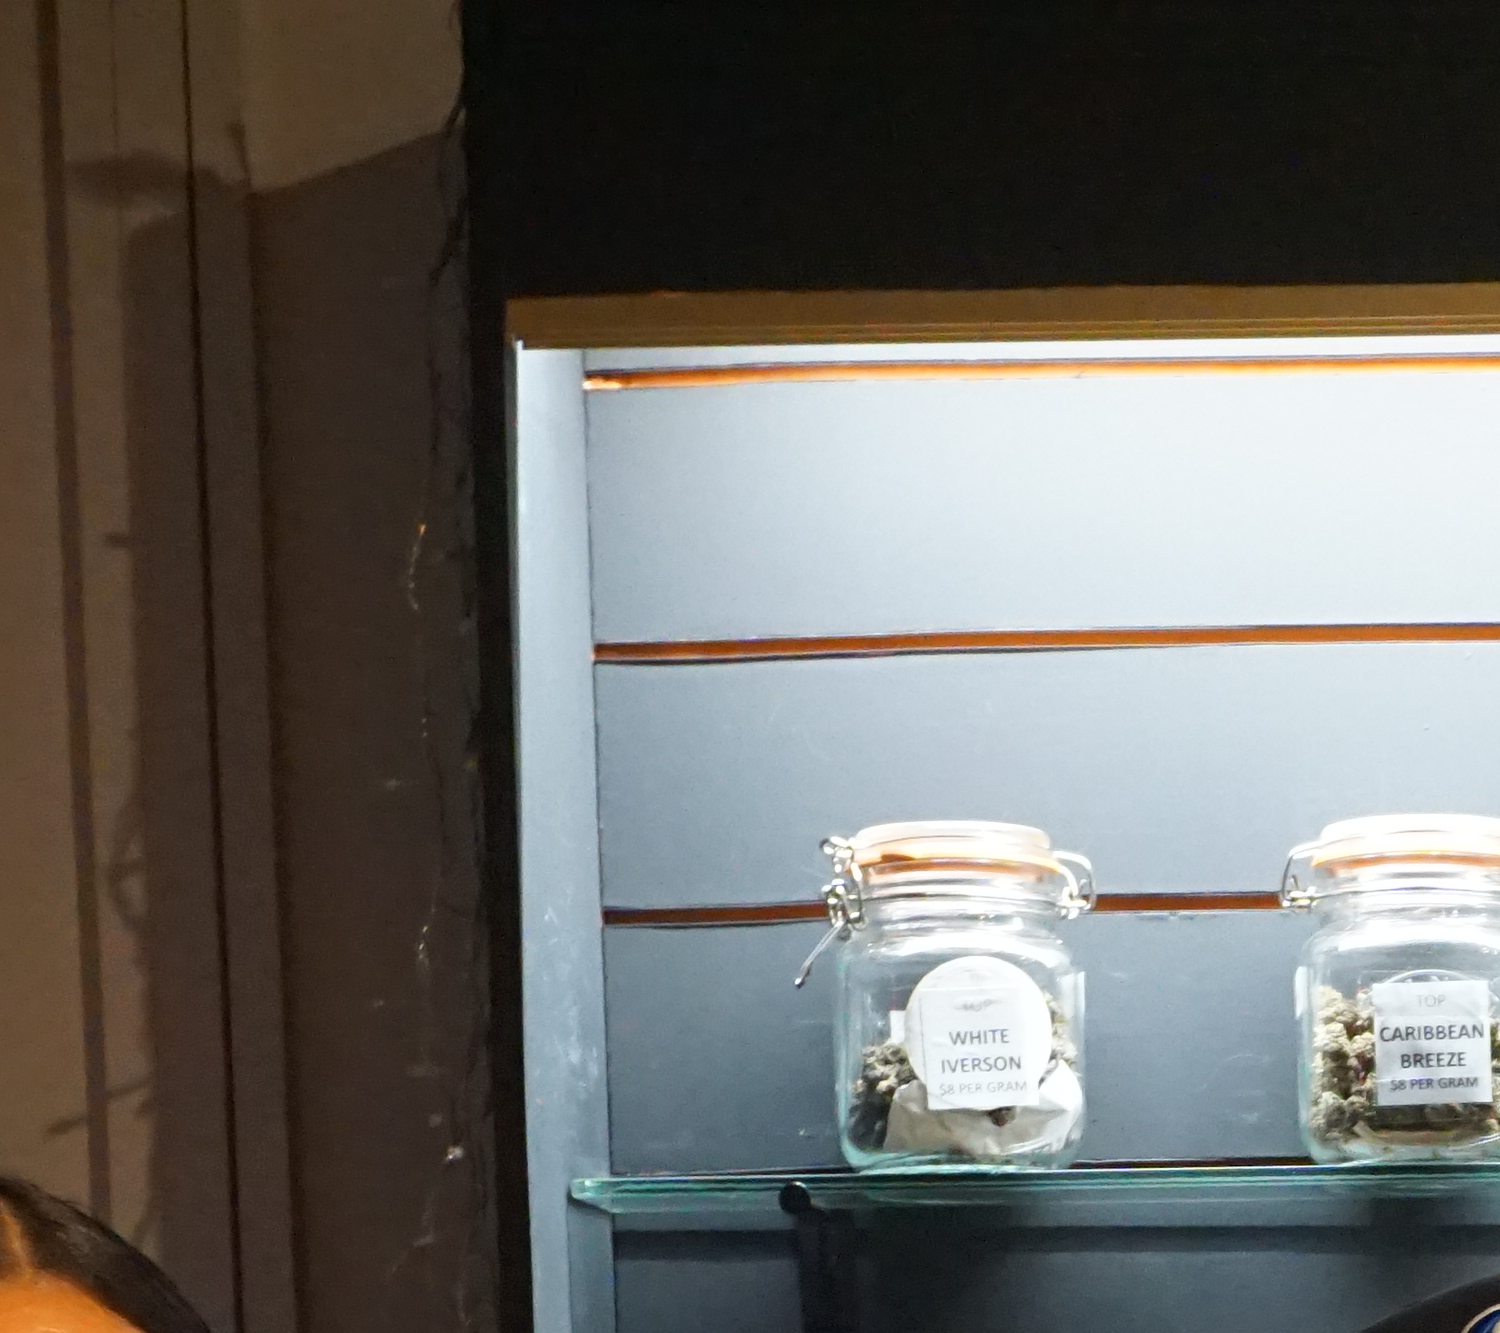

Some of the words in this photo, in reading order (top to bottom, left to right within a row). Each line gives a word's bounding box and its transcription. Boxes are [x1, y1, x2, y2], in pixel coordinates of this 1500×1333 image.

[948, 1028, 1010, 1046] WHITE
[1379, 1024, 1485, 1042] CARIBBEAN
[941, 1055, 1022, 1074] IVERSON
[1400, 1052, 1468, 1069] BREEZE
[959, 1082, 982, 1095] PER
[986, 1080, 1028, 1093] GRAM
[1409, 1078, 1435, 1090] PER
[1438, 1076, 1479, 1089] GRAM
